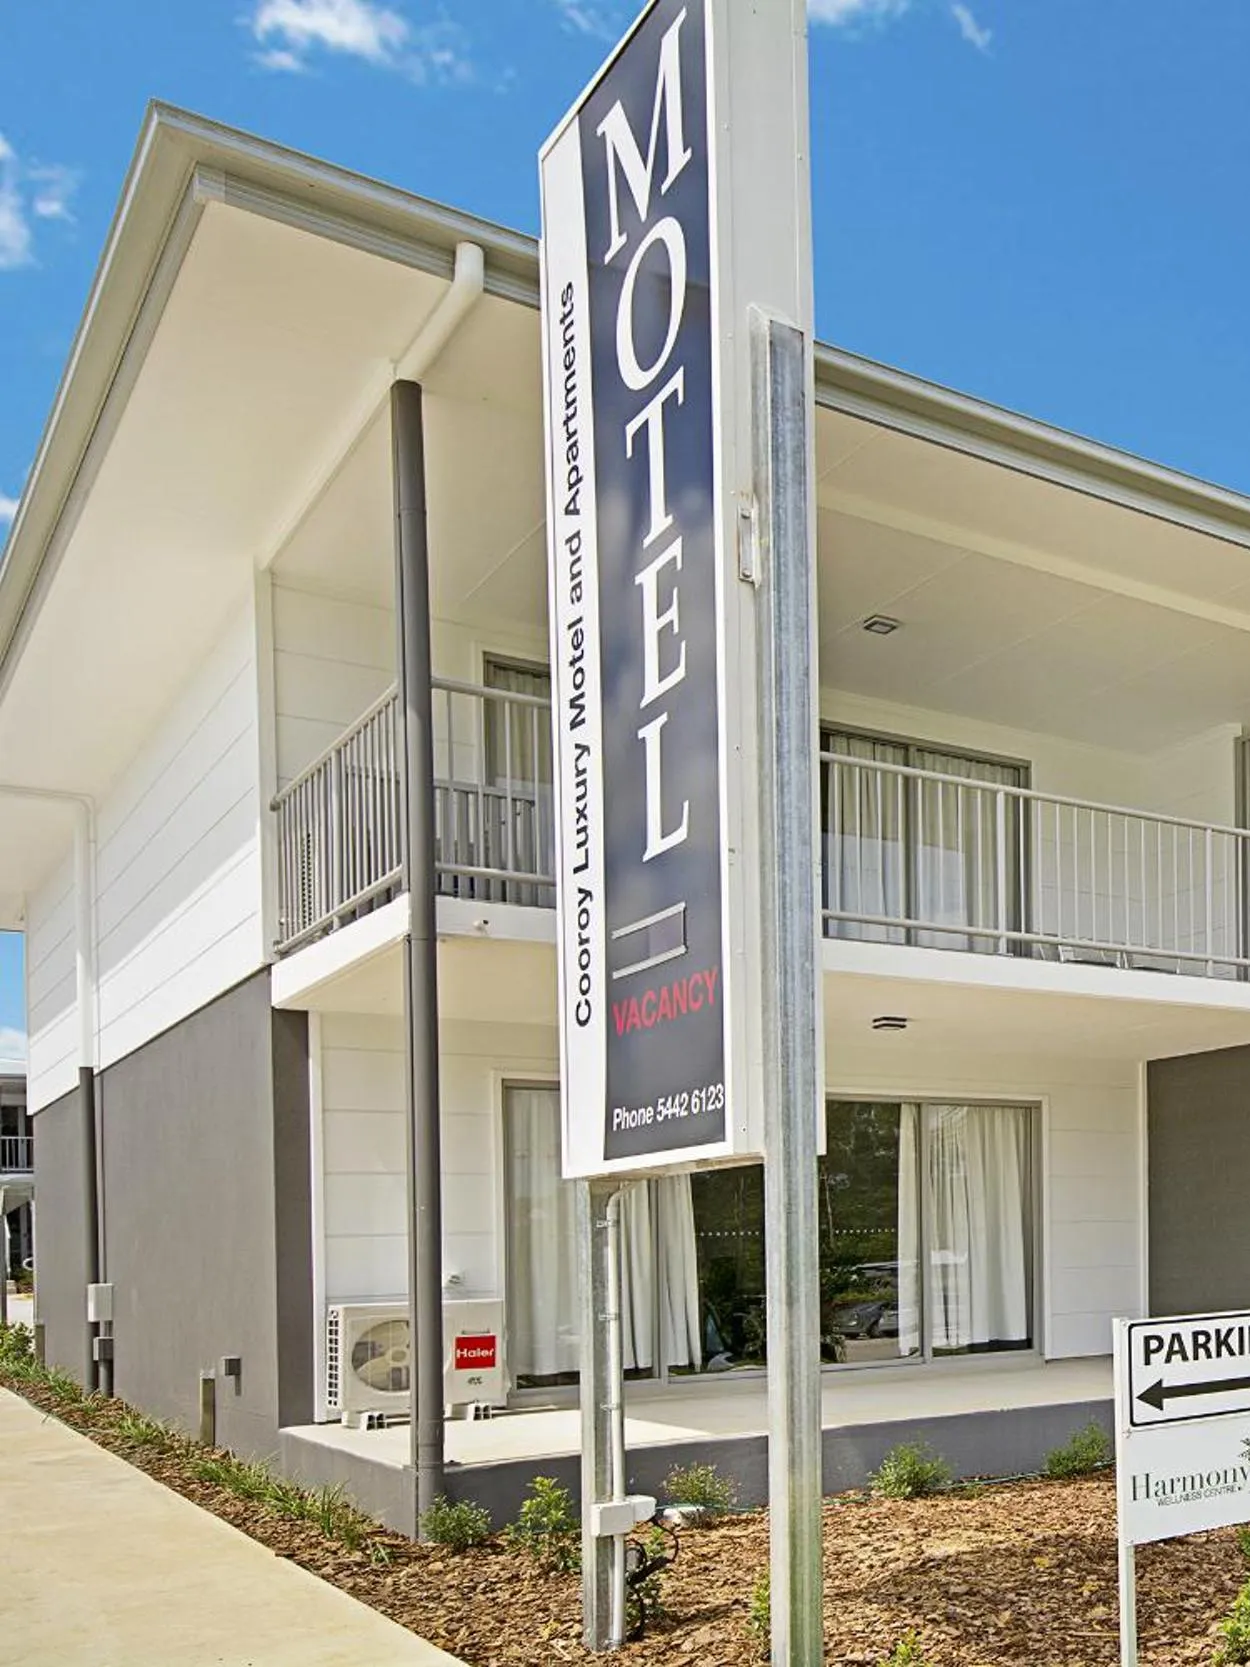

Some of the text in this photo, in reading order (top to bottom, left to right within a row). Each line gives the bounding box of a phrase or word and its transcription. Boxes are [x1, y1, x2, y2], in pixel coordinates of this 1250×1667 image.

[596, 7, 692, 863] MOTEL
[559, 281, 595, 1028] Cooroy Luxury Motel and Apartments
[612, 967, 718, 1036] VACANCY
[612, 1083, 725, 1132] Phone 5442 6123
[456, 1348, 494, 1358] Haier
[1156, 1485, 1236, 1506] WELLNESS CENTRE
